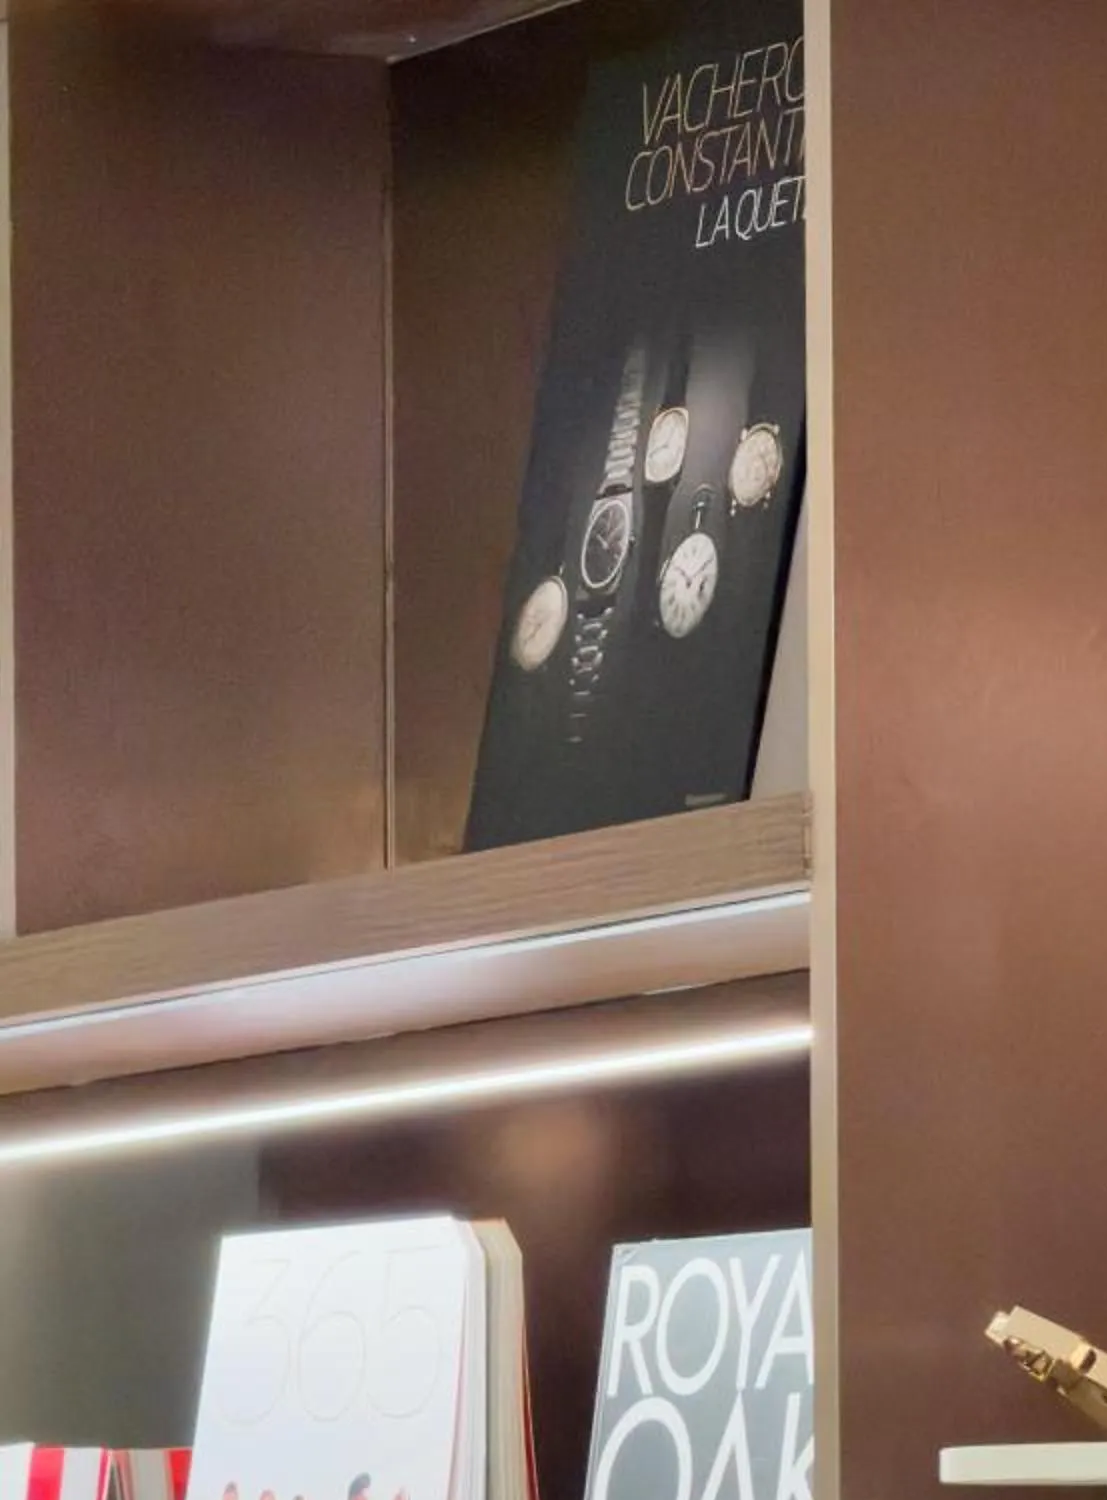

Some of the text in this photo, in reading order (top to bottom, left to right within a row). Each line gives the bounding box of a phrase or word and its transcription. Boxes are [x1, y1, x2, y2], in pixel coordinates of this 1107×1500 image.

[642, 35, 805, 145] VACHERO
[695, 175, 807, 248] LA QUET
[607, 1249, 814, 1398] ROYA
